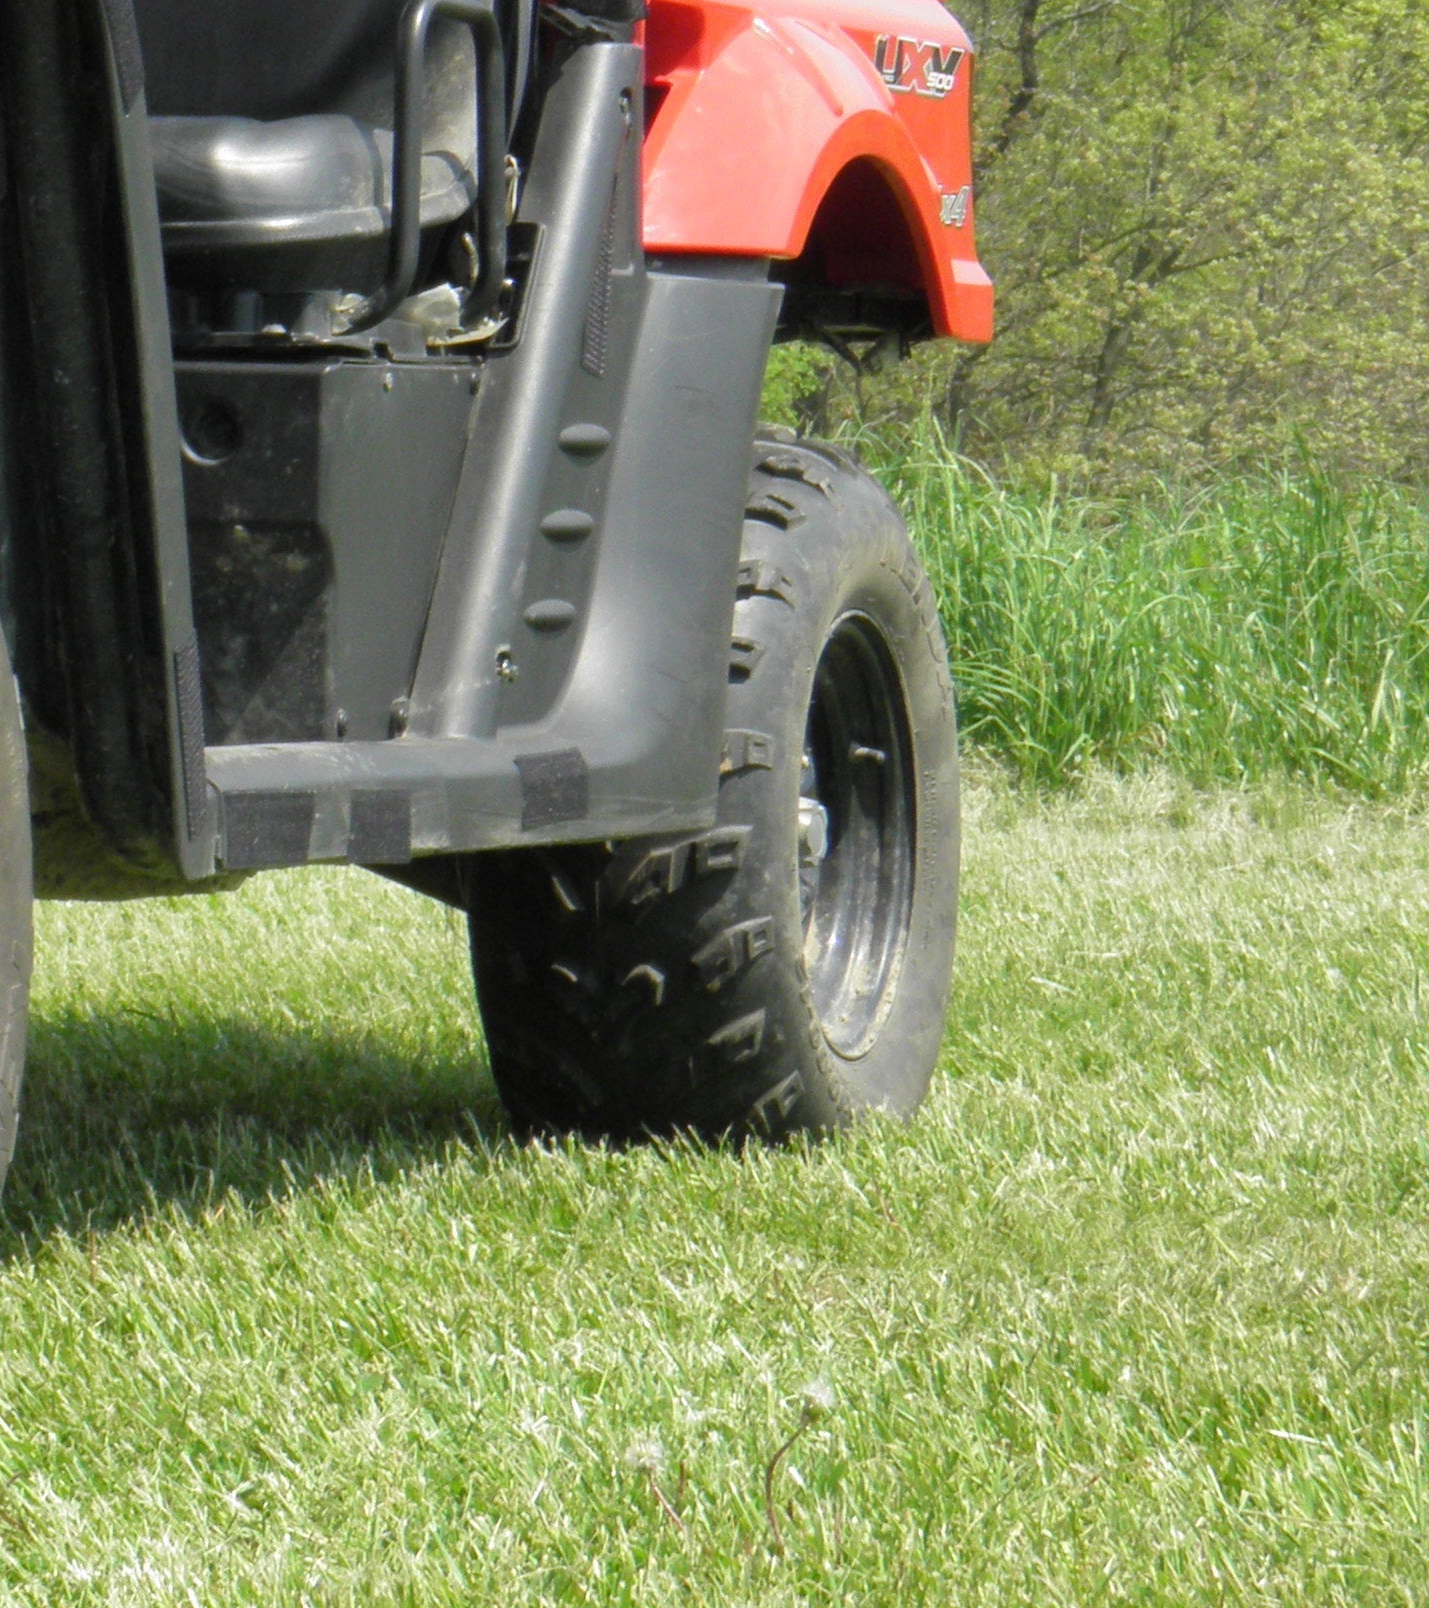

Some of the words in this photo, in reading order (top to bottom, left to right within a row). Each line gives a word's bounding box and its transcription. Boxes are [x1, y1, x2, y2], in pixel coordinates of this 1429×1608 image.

[874, 33, 965, 98] UXV
[926, 71, 956, 93] 500
[937, 184, 971, 228] x4
